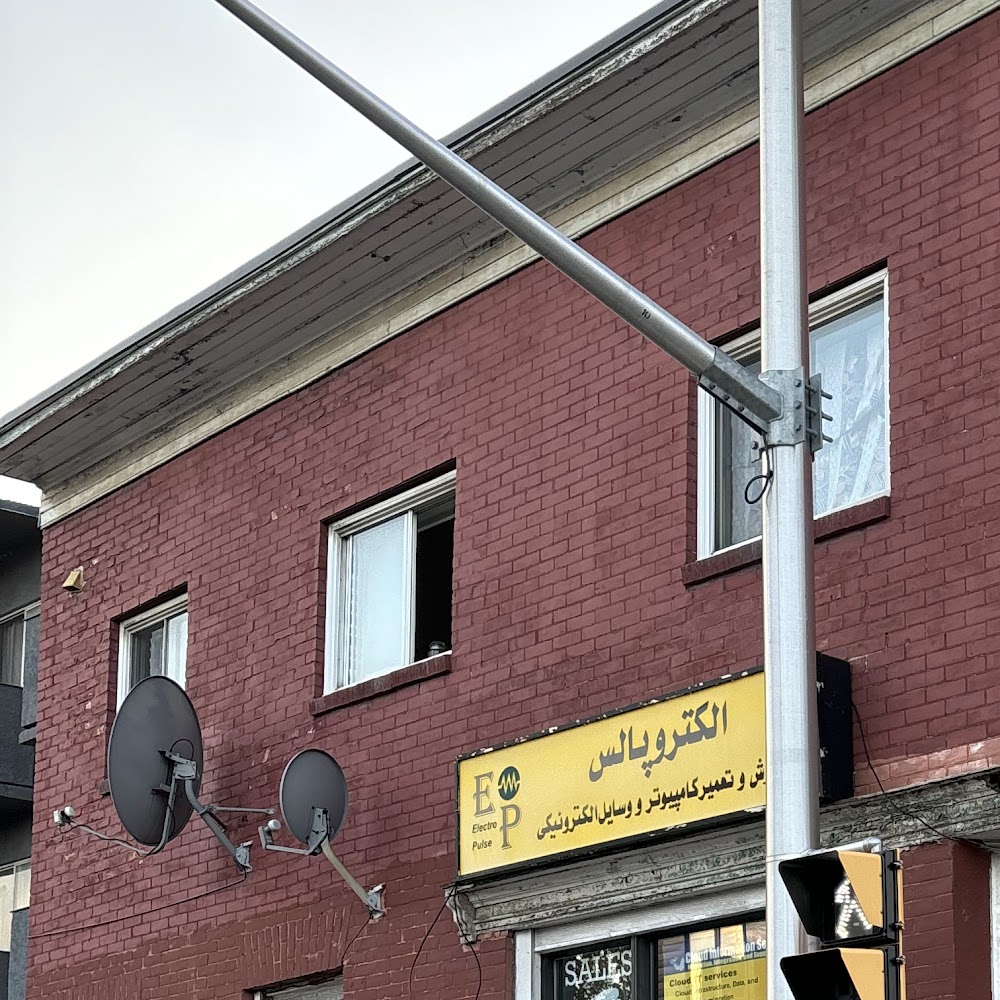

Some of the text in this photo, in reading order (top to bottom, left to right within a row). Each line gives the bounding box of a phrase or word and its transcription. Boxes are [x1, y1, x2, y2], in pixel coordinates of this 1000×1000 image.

[473, 771, 495, 818] E
[472, 820, 497, 834] Electro
[500, 804, 522, 850] P
[472, 839, 492, 851] Pulse
[565, 950, 632, 987] SALES
[670, 977, 691, 987] Cloud
[704, 969, 738, 981] services
[747, 977, 758, 985] and
